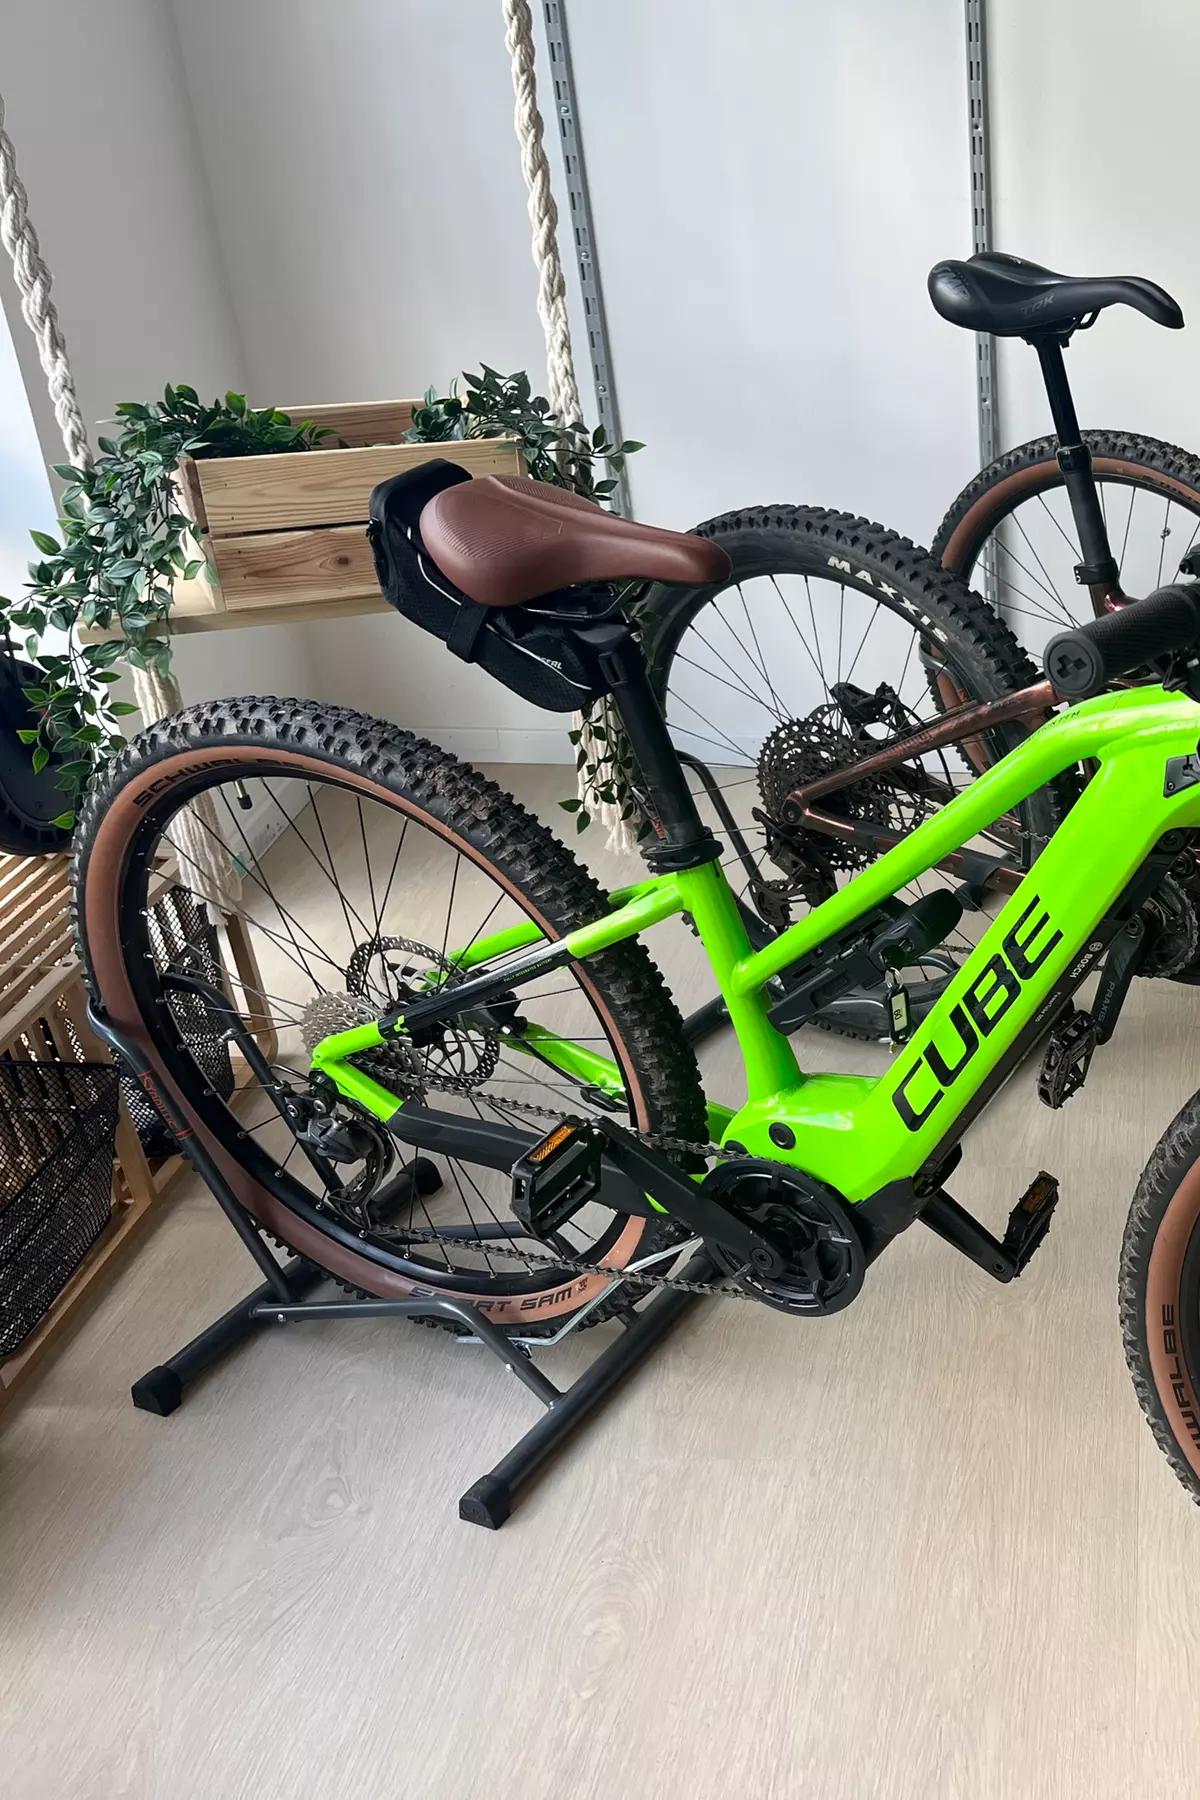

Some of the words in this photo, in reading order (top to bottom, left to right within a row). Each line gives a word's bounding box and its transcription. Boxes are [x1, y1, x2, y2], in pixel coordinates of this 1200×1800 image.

[1021, 293, 1055, 315] TRK
[827, 556, 949, 643] MAXXIS
[133, 758, 305, 808] SCHWA
[1069, 953, 1094, 978] BOSCH
[891, 894, 1064, 1132] CUBE
[1098, 980, 1116, 1023] PRAXIS
[519, 1286, 572, 1311] SAM
